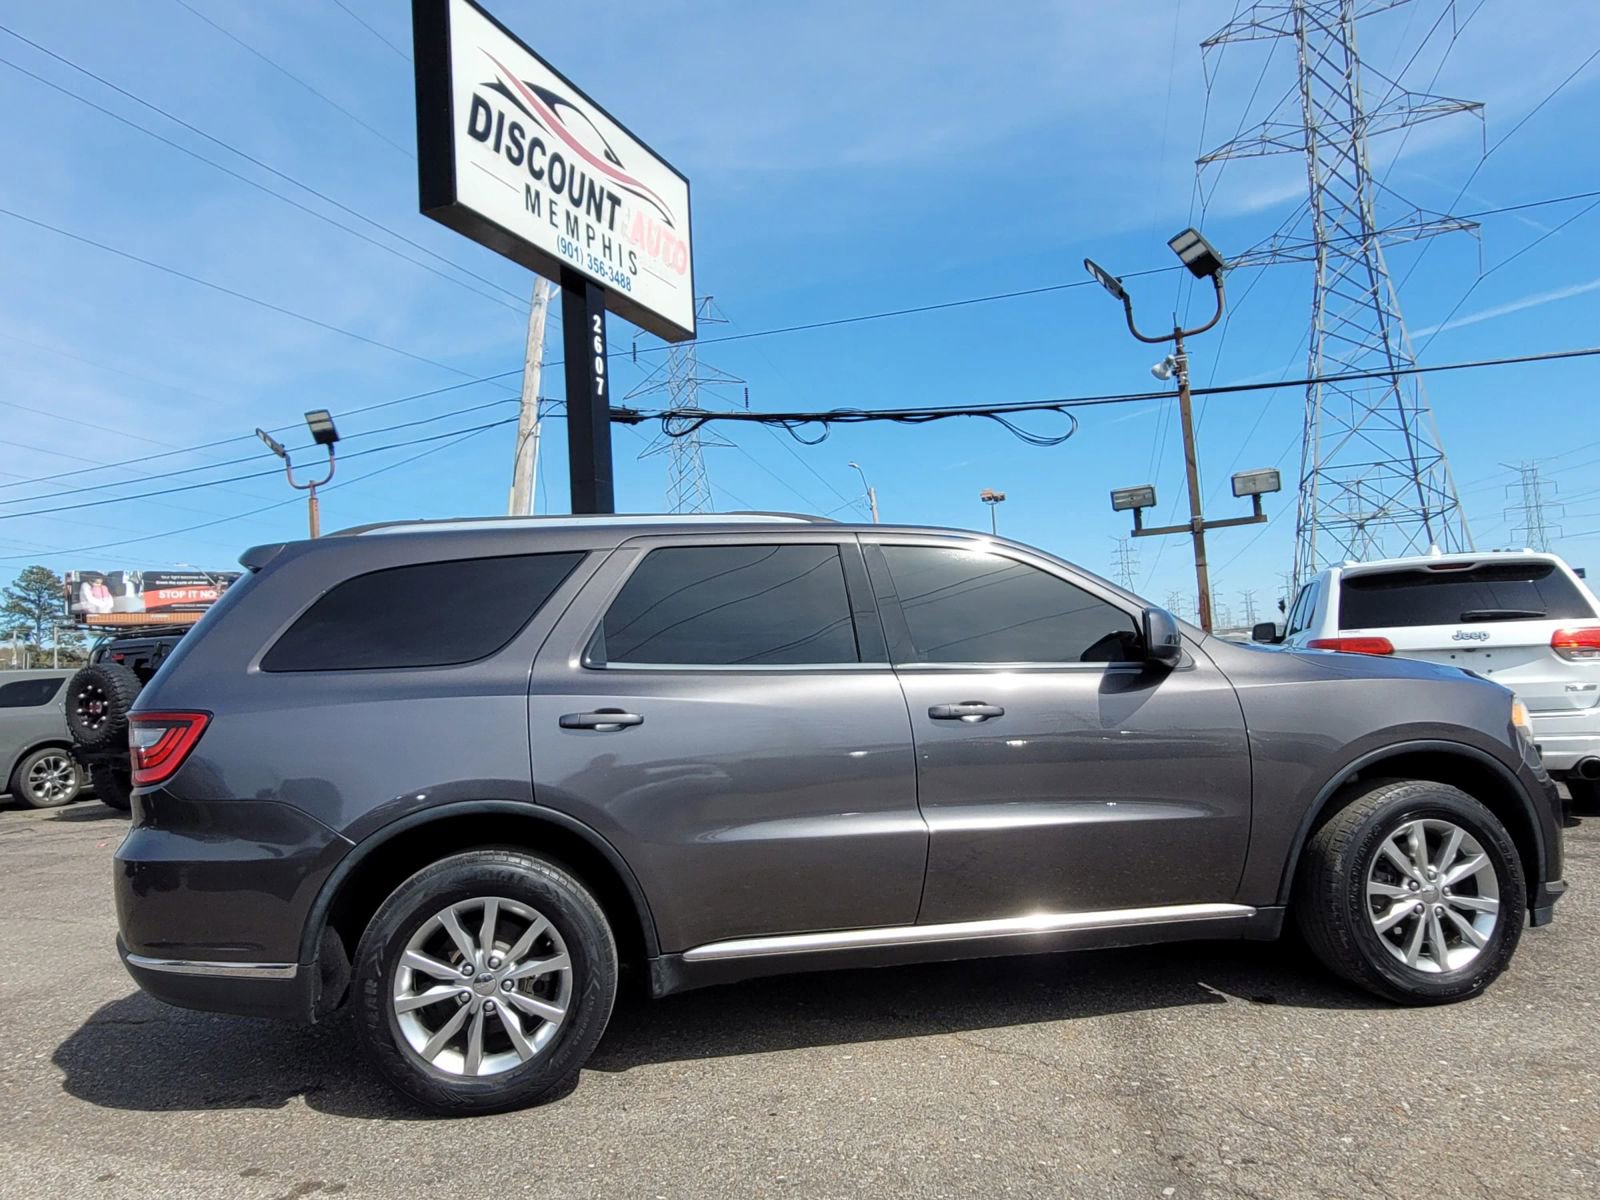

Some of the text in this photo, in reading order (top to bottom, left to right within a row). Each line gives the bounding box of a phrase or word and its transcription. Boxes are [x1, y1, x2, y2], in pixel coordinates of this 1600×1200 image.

[467, 92, 622, 233] DISCOUNT
[525, 182, 638, 276] MEMPHIS
[557, 234, 631, 292] (901) 356-3488
[593, 314, 604, 395] 2607
[159, 589, 223, 599] STOP IT NO
[1452, 630, 1490, 642] Jeep
